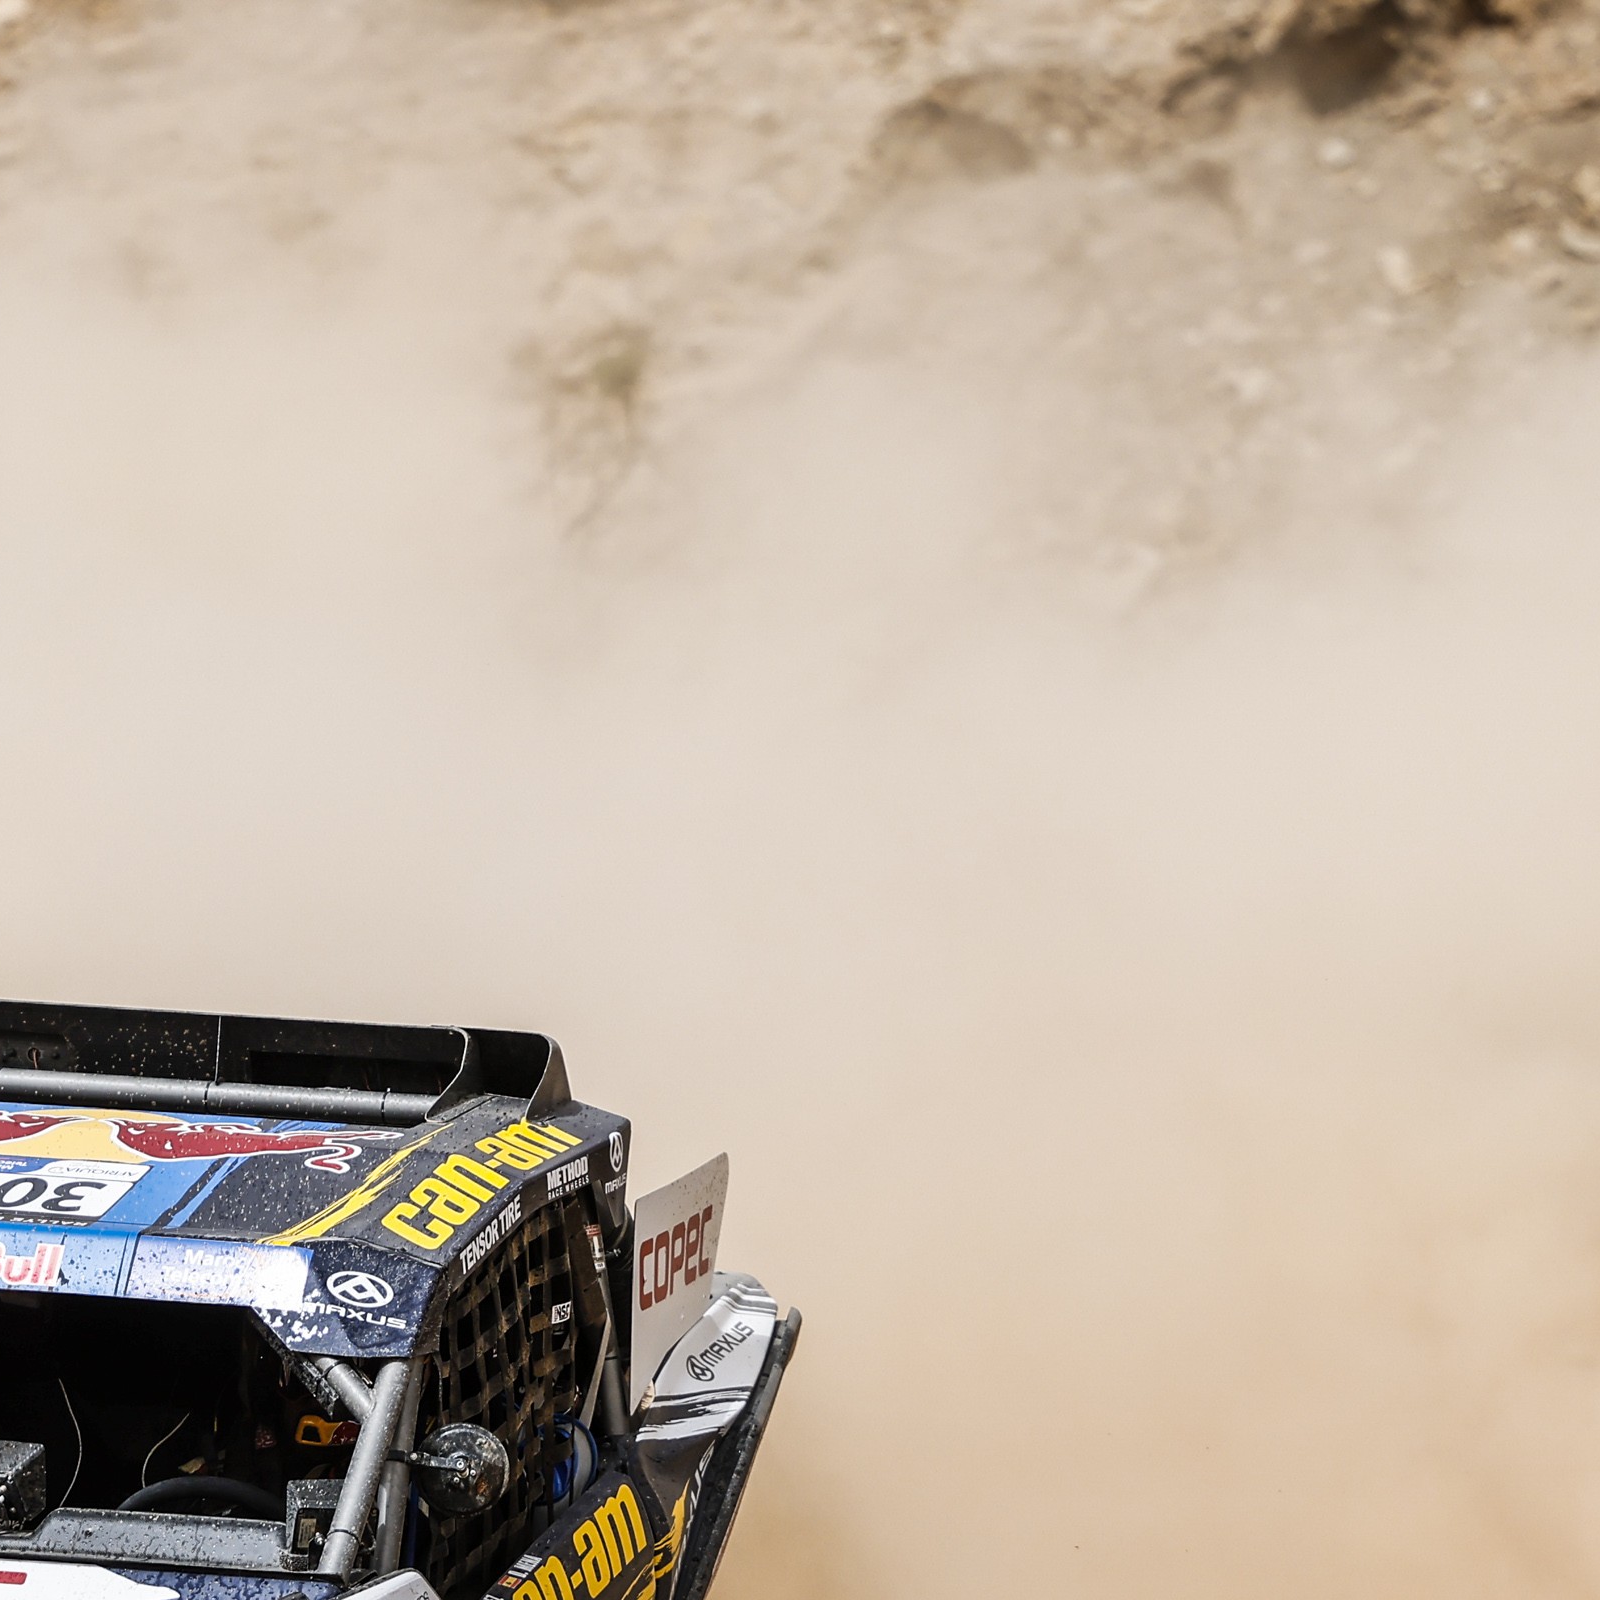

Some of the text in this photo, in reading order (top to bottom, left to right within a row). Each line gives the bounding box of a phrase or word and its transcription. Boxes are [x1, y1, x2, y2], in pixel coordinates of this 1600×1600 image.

[65, 1165, 139, 1178] AFRIQUIA
[381, 1117, 583, 1250] can-am
[546, 1156, 589, 1191] METHOD
[548, 1175, 590, 1200] RACE WHEELS
[459, 1194, 522, 1275] TENSOR TIRE
[700, 1321, 755, 1368] MAXUS
